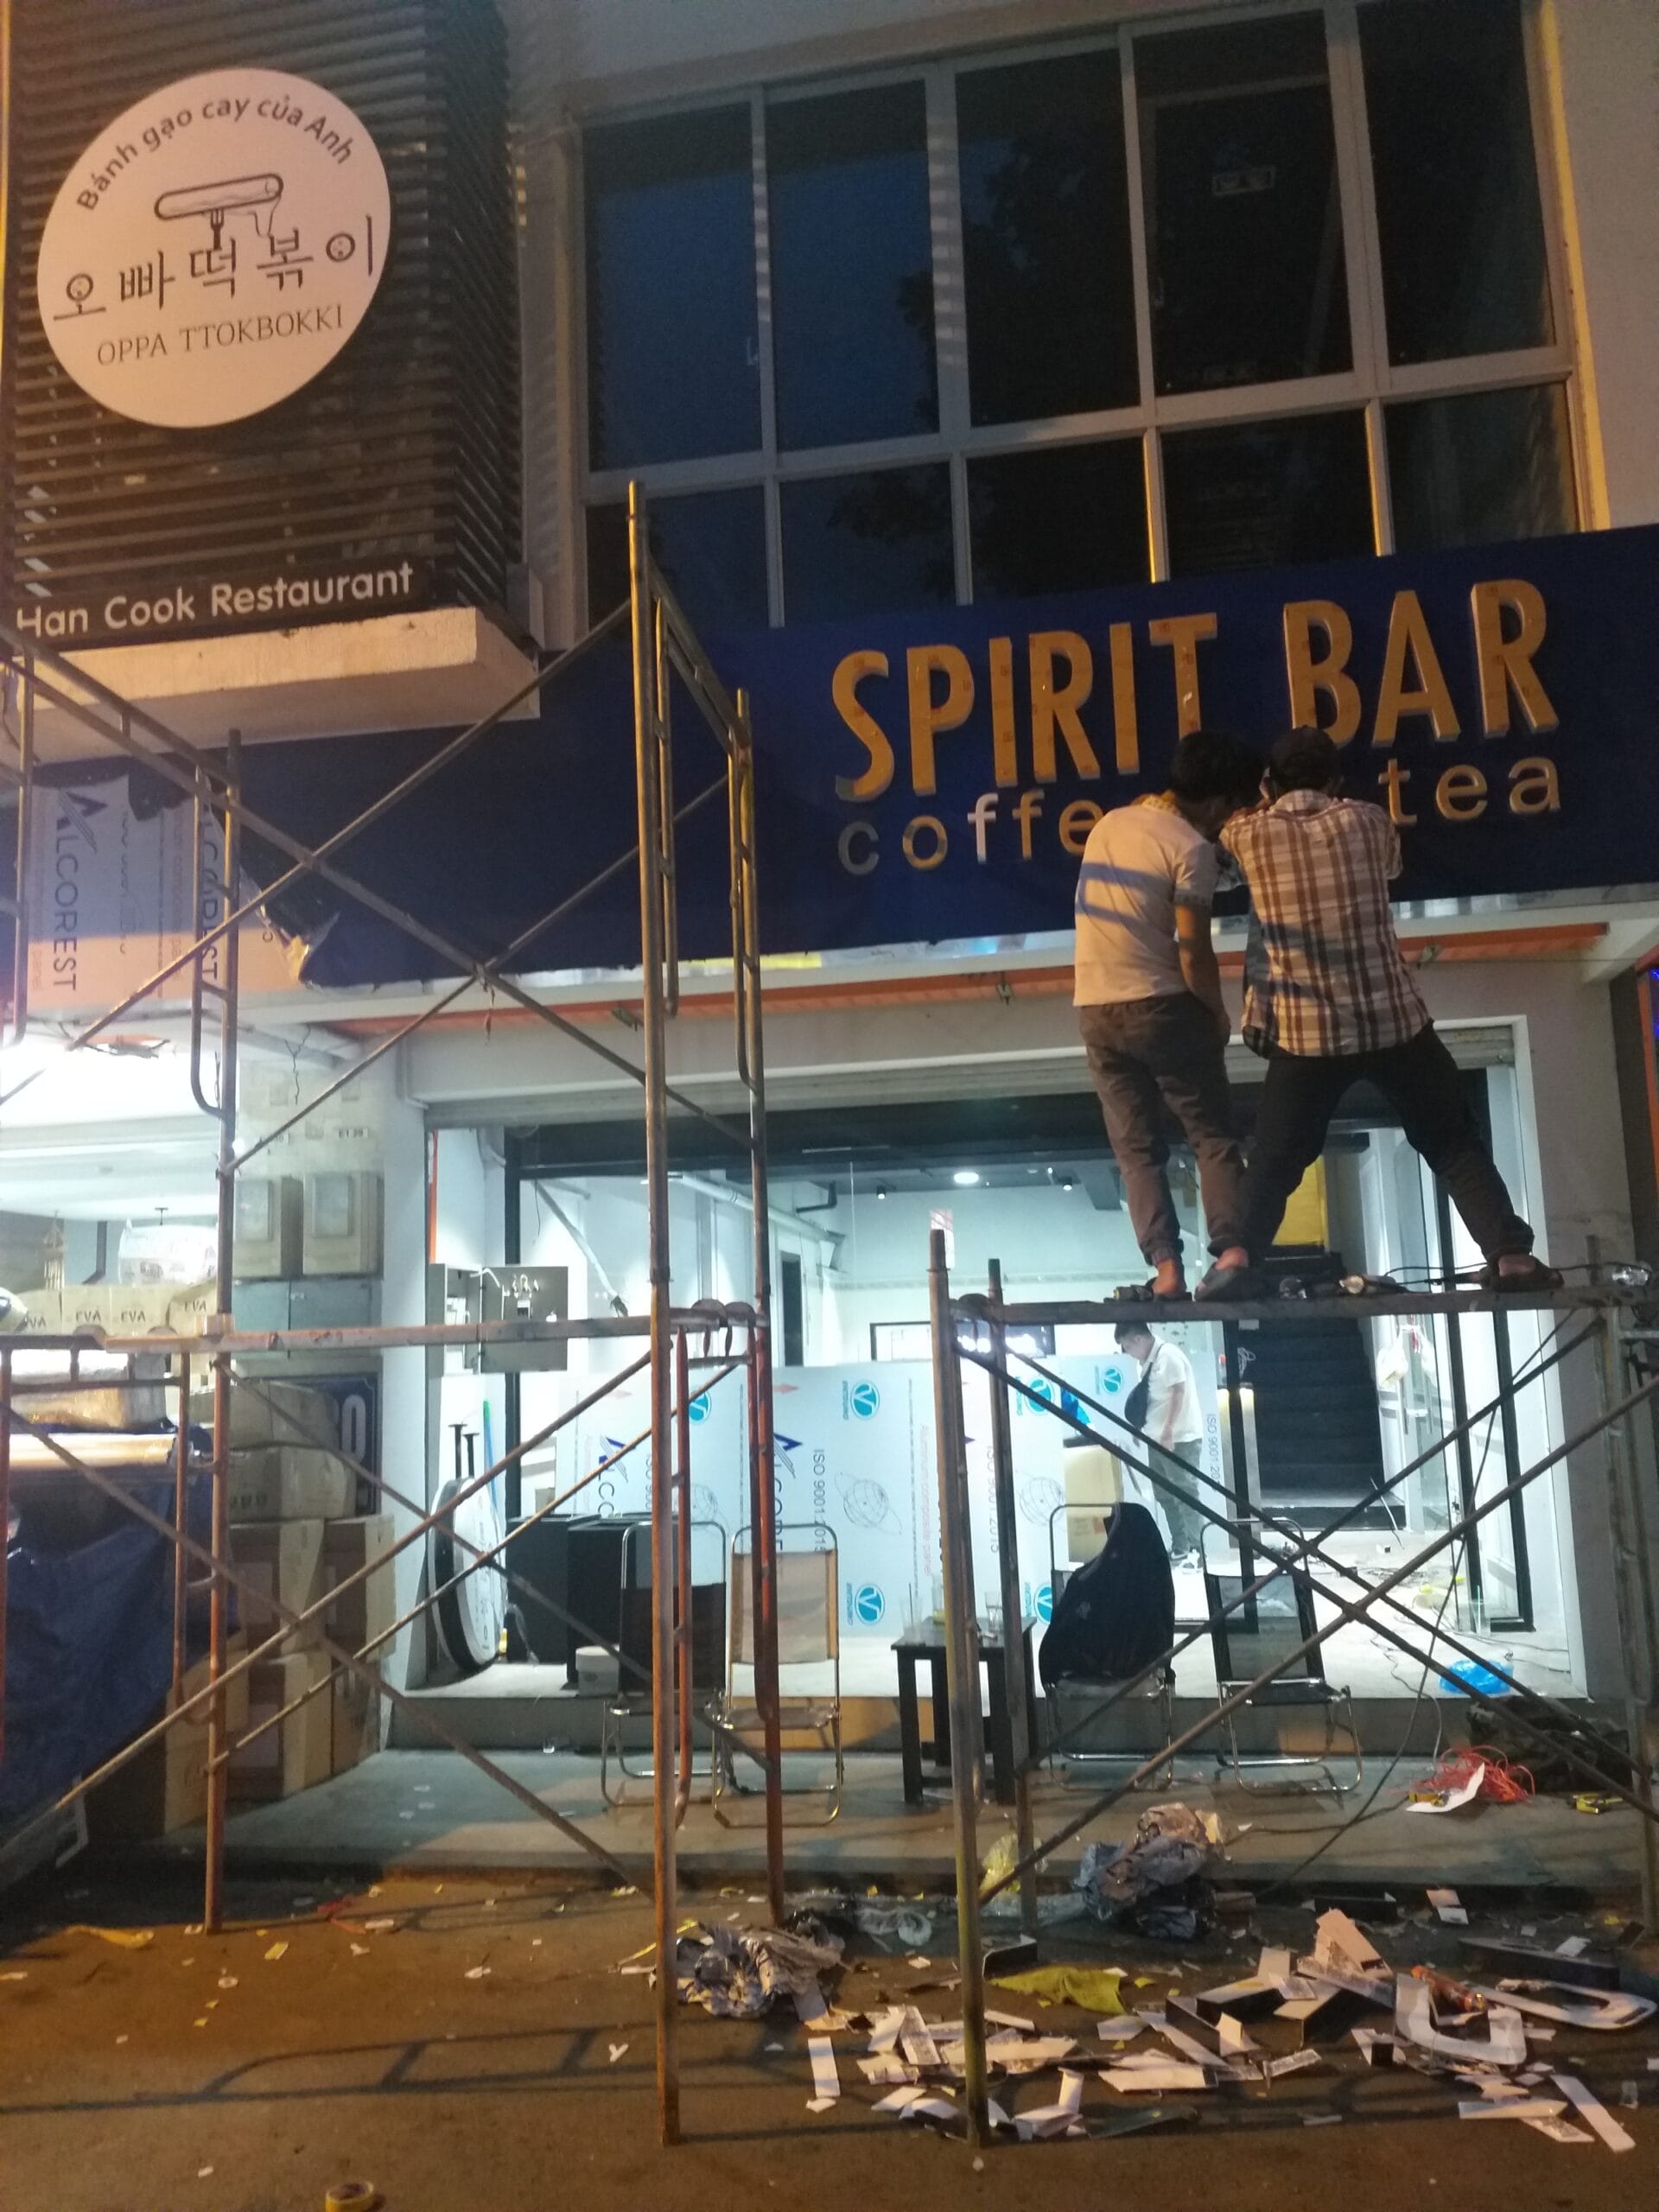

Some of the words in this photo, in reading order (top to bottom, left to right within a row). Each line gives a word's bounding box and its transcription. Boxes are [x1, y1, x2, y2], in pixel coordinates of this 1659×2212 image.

[77, 142, 138, 211] Bánh
[142, 107, 194, 153] gạo
[201, 97, 251, 123] cay
[257, 94, 303, 127] của
[304, 115, 352, 165] Anh
[97, 333, 168, 366] OPPA
[179, 303, 343, 353] TTOKBOKKI
[16, 606, 87, 638] Han
[105, 587, 195, 629] Cook
[212, 562, 413, 617] Restaurant
[831, 613, 1219, 803] SPIRIT
[1283, 578, 1560, 748] BAR
[835, 788, 1104, 876] coffe
[1377, 756, 1562, 826] tea
[813, 1448, 825, 1477] ISO
